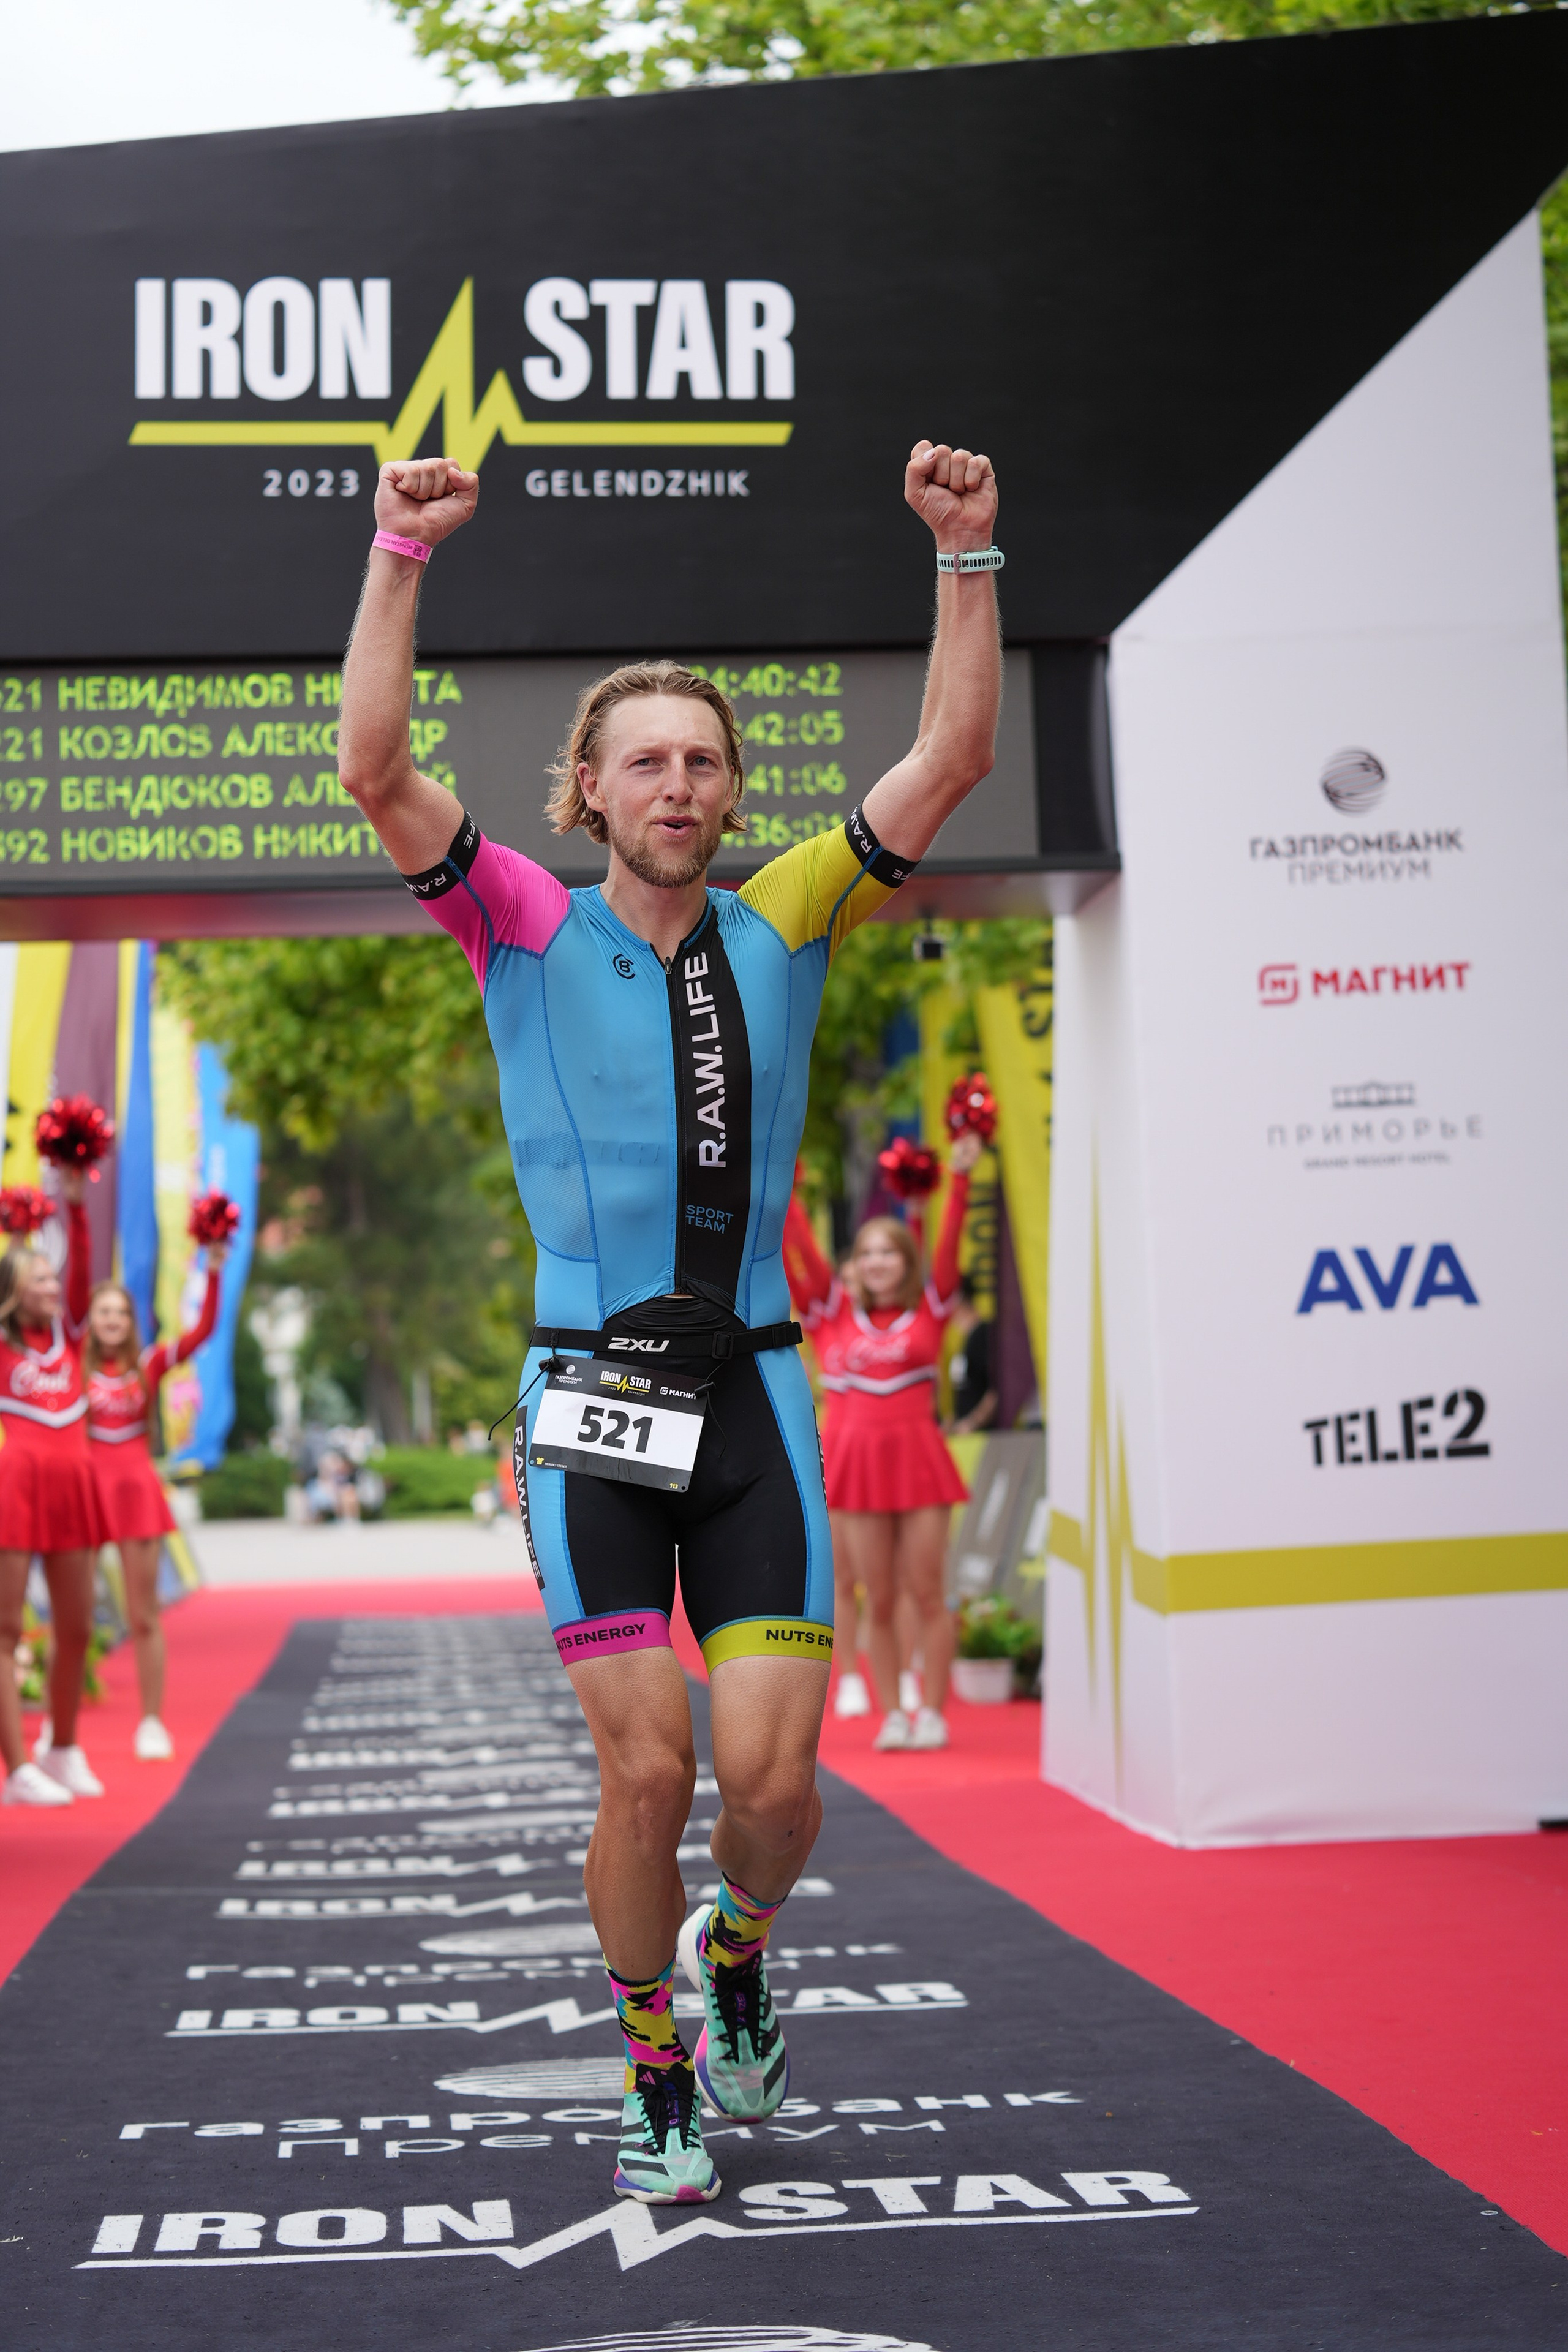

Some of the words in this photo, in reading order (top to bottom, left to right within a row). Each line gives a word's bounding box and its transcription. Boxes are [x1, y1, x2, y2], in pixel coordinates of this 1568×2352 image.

[135, 276, 391, 400] IRON
[523, 277, 796, 401] STAR
[263, 469, 360, 497] 2023
[525, 469, 750, 497] GELENDZHIK
[0, 676, 42, 712] 21
[58, 673, 293, 718] НЕВИДИМОВ
[304, 669, 463, 707] НТА
[690, 662, 843, 698] 4:40:42
[0, 726, 43, 762] 21
[0, 776, 49, 813] 97
[59, 772, 273, 820] БЕНДЮКОВ
[61, 823, 243, 864] НОВИКОВ
[253, 820, 393, 859] НИКИТ
[1250, 827, 1464, 861] ГАЗПРОМБАНК
[1288, 857, 1431, 885] ПРЕМИУМ
[1312, 962, 1471, 997] МАГНИТ
[685, 952, 726, 1168] R.A.W.LIFE
[1267, 1113, 1483, 1149] ПРИМОРЬЕ
[685, 1214, 726, 1234] TEAM
[686, 1204, 734, 1224] SPORT
[1296, 1243, 1480, 1315] AVA
[608, 1337, 669, 1352] 2XU
[600, 1370, 622, 1384] IRON
[629, 1376, 652, 1390] STAR
[576, 1404, 654, 1453] 521
[1303, 1388, 1491, 1467] TELE2
[573, 1623, 646, 1646] ENERGY
[766, 1629, 815, 1644] NUTS
[176, 2001, 480, 2031] IRON
[91, 2199, 514, 2254] IRON
[738, 2171, 1192, 2221] STAR
